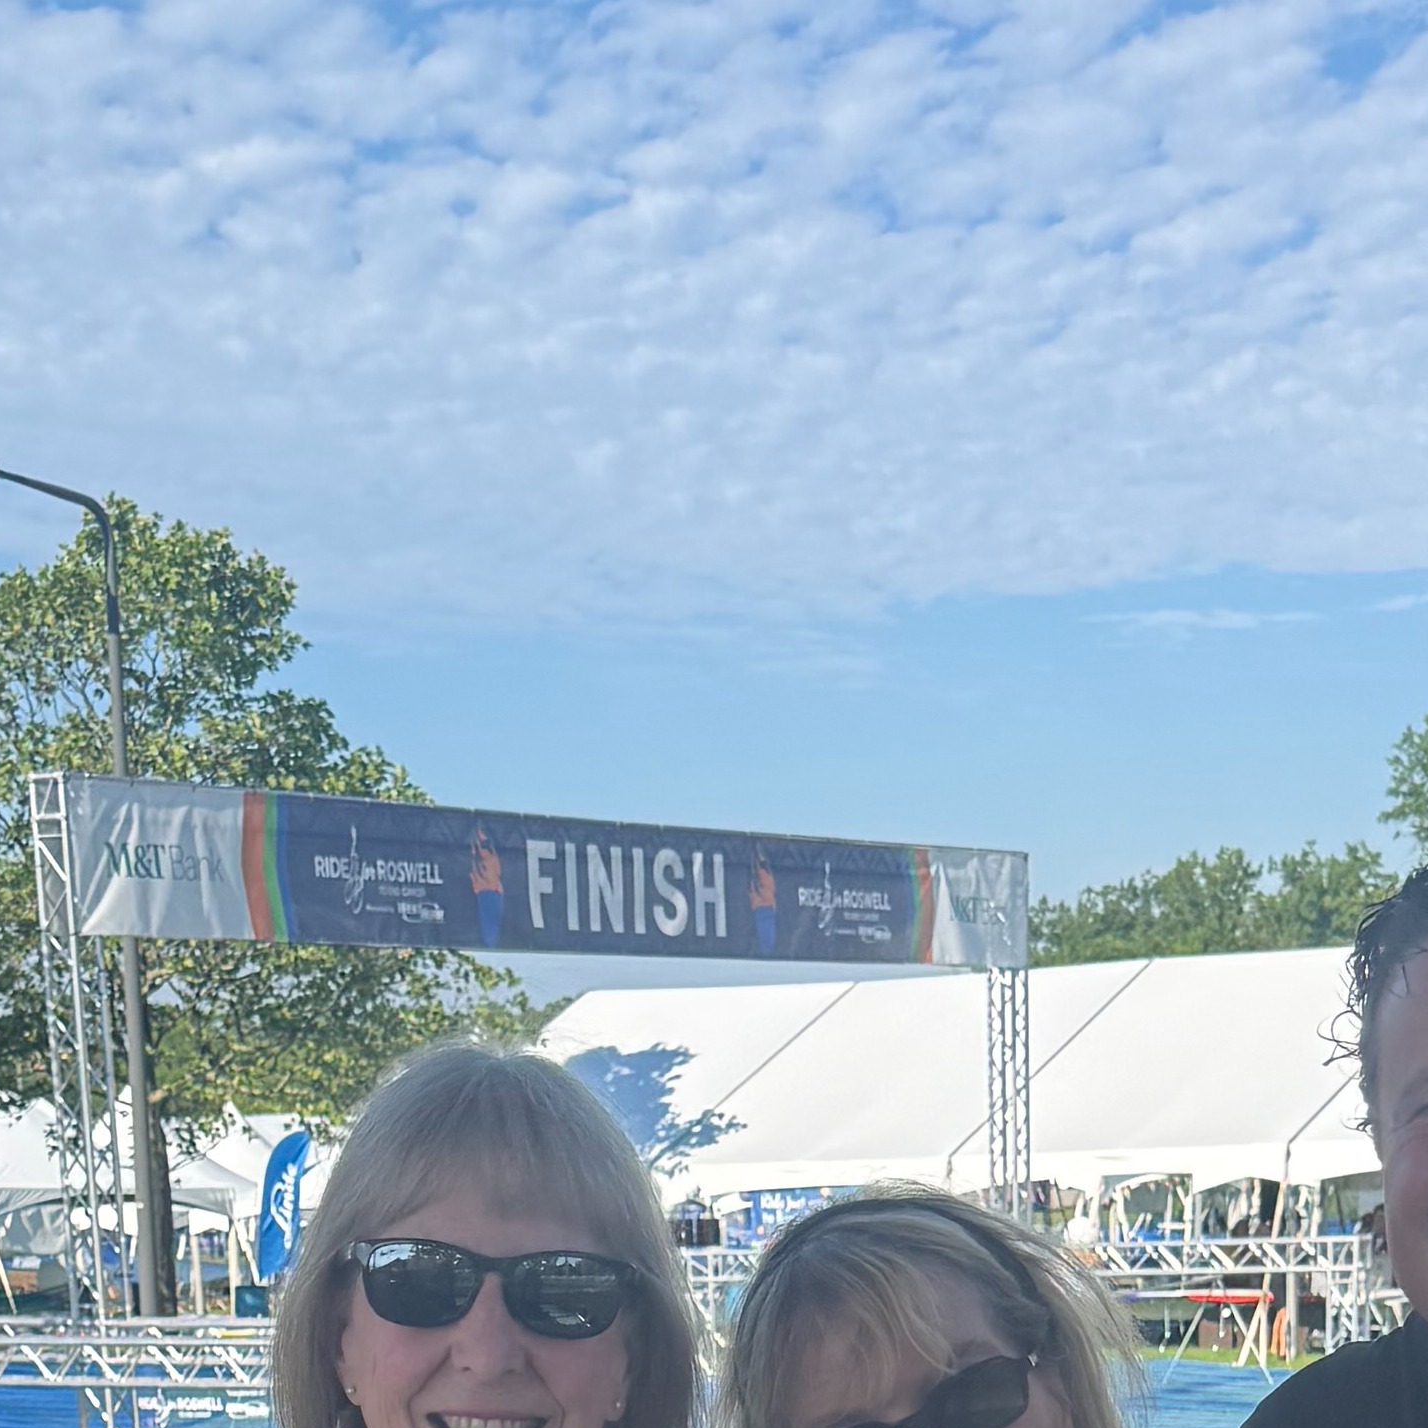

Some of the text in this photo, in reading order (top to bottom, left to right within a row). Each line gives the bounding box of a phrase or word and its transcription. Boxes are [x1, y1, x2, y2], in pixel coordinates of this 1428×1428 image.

[104, 841, 224, 883] M&T Bank
[314, 855, 351, 879] RIDE
[376, 859, 444, 885] ROSWELL
[526, 839, 727, 938] FINISH
[843, 889, 892, 911] ROSWELL
[270, 1162, 298, 1250] Linde
